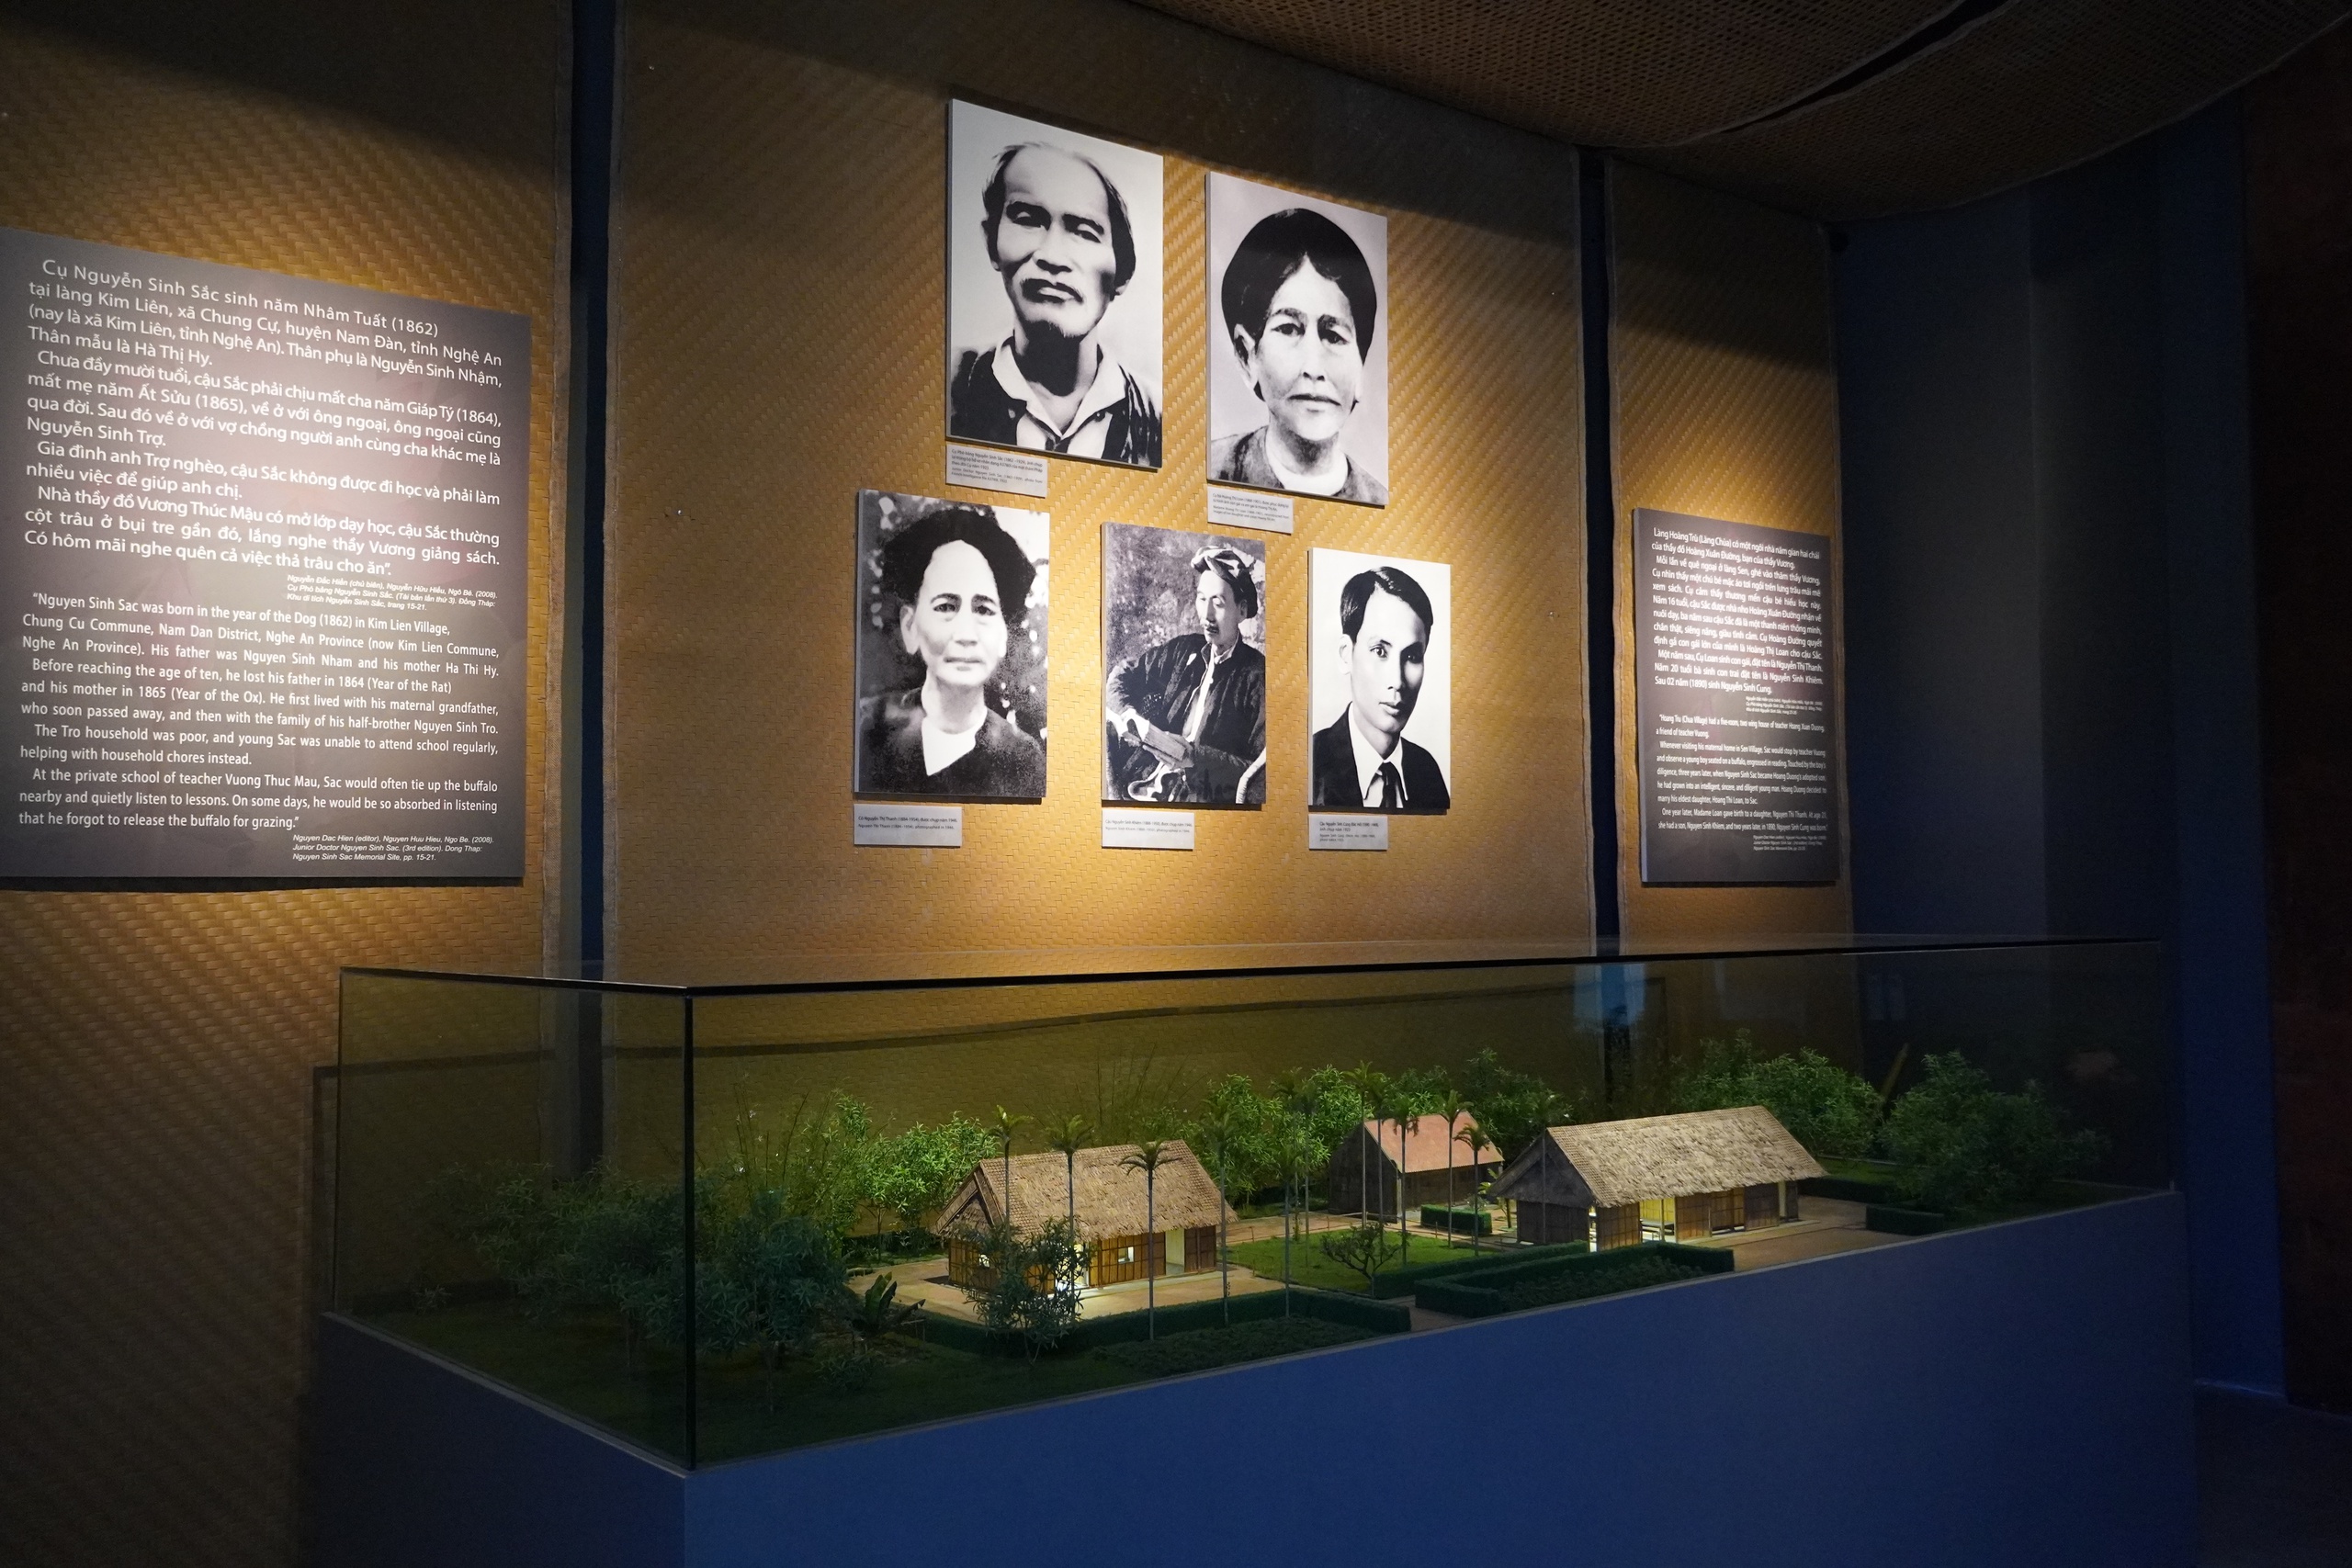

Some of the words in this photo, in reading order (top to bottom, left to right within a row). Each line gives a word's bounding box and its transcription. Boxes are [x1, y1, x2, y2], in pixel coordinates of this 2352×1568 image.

[42, 259, 67, 279] Cụ
[74, 265, 141, 289] Nguyễn
[148, 277, 185, 296] Sinh
[190, 284, 220, 301] Sắc
[224, 291, 258, 308] sinh
[264, 298, 298, 314] năm
[304, 302, 349, 322] Nhâm
[353, 310, 387, 329] Tuất
[391, 316, 438, 338] (1862)
[28, 282, 51, 299] tại
[56, 284, 92, 307] làng
[98, 291, 130, 310] Kim
[135, 297, 173, 318] Liên,
[177, 305, 196, 320] xã
[200, 308, 252, 332] Chung
[256, 317, 281, 334] Cự,
[286, 320, 332, 342] huyện
[336, 328, 369, 346] Nam
[373, 334, 407, 354] Đàn,
[410, 340, 438, 357] tỉnh
[443, 344, 480, 366] Nghệ
[483, 352, 502, 367] An
[28, 325, 71, 344] Thân
[75, 333, 112, 351] mẫu
[117, 337, 130, 354] là
[135, 341, 156, 357] Hà
[162, 344, 184, 364] Thị
[188, 349, 212, 367] Hy.
[27, 415, 93, 438] Nguyễn
[97, 424, 133, 442] Sinh
[137, 429, 167, 448] Trợ.
[26, 462, 74, 480] nhiều
[78, 468, 113, 486] việc
[116, 470, 138, 487] để
[141, 475, 178, 493] giúp
[181, 479, 211, 494] anh
[215, 482, 243, 501] chị.
[37, 440, 65, 457] Gia
[68, 444, 107, 461] đình
[109, 449, 141, 465] anh
[143, 452, 171, 471] Trợ
[173, 457, 227, 477] nghèo,
[231, 463, 257, 479] cậu
[261, 466, 287, 481] Sắc
[289, 468, 337, 490] không
[340, 475, 377, 493] được
[379, 479, 392, 493] đi
[396, 480, 423, 497] học
[424, 485, 440, 499] và
[443, 487, 473, 502] phải
[475, 490, 500, 505] làm
[24, 529, 48, 546] Có
[51, 531, 91, 549] hôm
[95, 537, 126, 552] mãi
[130, 540, 172, 558] nghe
[175, 545, 216, 560] quên
[220, 547, 237, 562] cả
[241, 550, 272, 567] việc
[275, 552, 300, 568] thả
[303, 556, 333, 570] trâu
[336, 558, 364, 573] cho
[88, 596, 115, 610] Sinh
[118, 598, 139, 612] Sac
[141, 603, 164, 614] was
[166, 602, 194, 615] born
[197, 604, 208, 616] in
[210, 605, 230, 618] the
[232, 610, 256, 622] year
[259, 609, 271, 621] of
[273, 610, 291, 623] the
[294, 611, 316, 627] Dog
[319, 614, 352, 628] (1862)
[355, 616, 365, 628] in
[368, 616, 388, 629] Kim
[390, 618, 412, 631] Lien
[413, 620, 450, 637] Village,
[20, 745, 67, 762] helping
[71, 747, 97, 760] with
[101, 747, 164, 762] household
[166, 750, 205, 763] chores
[208, 751, 252, 765] instead.
[18, 811, 44, 824] that
[48, 811, 63, 824] he
[66, 811, 105, 829] forgot
[107, 814, 120, 826] to
[123, 813, 165, 826] release
[167, 813, 187, 826] the
[190, 814, 231, 827] buffalo
[232, 814, 249, 828] for
[292, 834, 321, 842] Nguyen
[355, 835, 381, 843] (editor),
[382, 835, 409, 843] Nguyen
[444, 836, 458, 844] Ngo
[471, 836, 494, 844] (2008).
[292, 852, 321, 862] Nguyen
[338, 852, 353, 861] Sac
[386, 852, 401, 861] Site,
